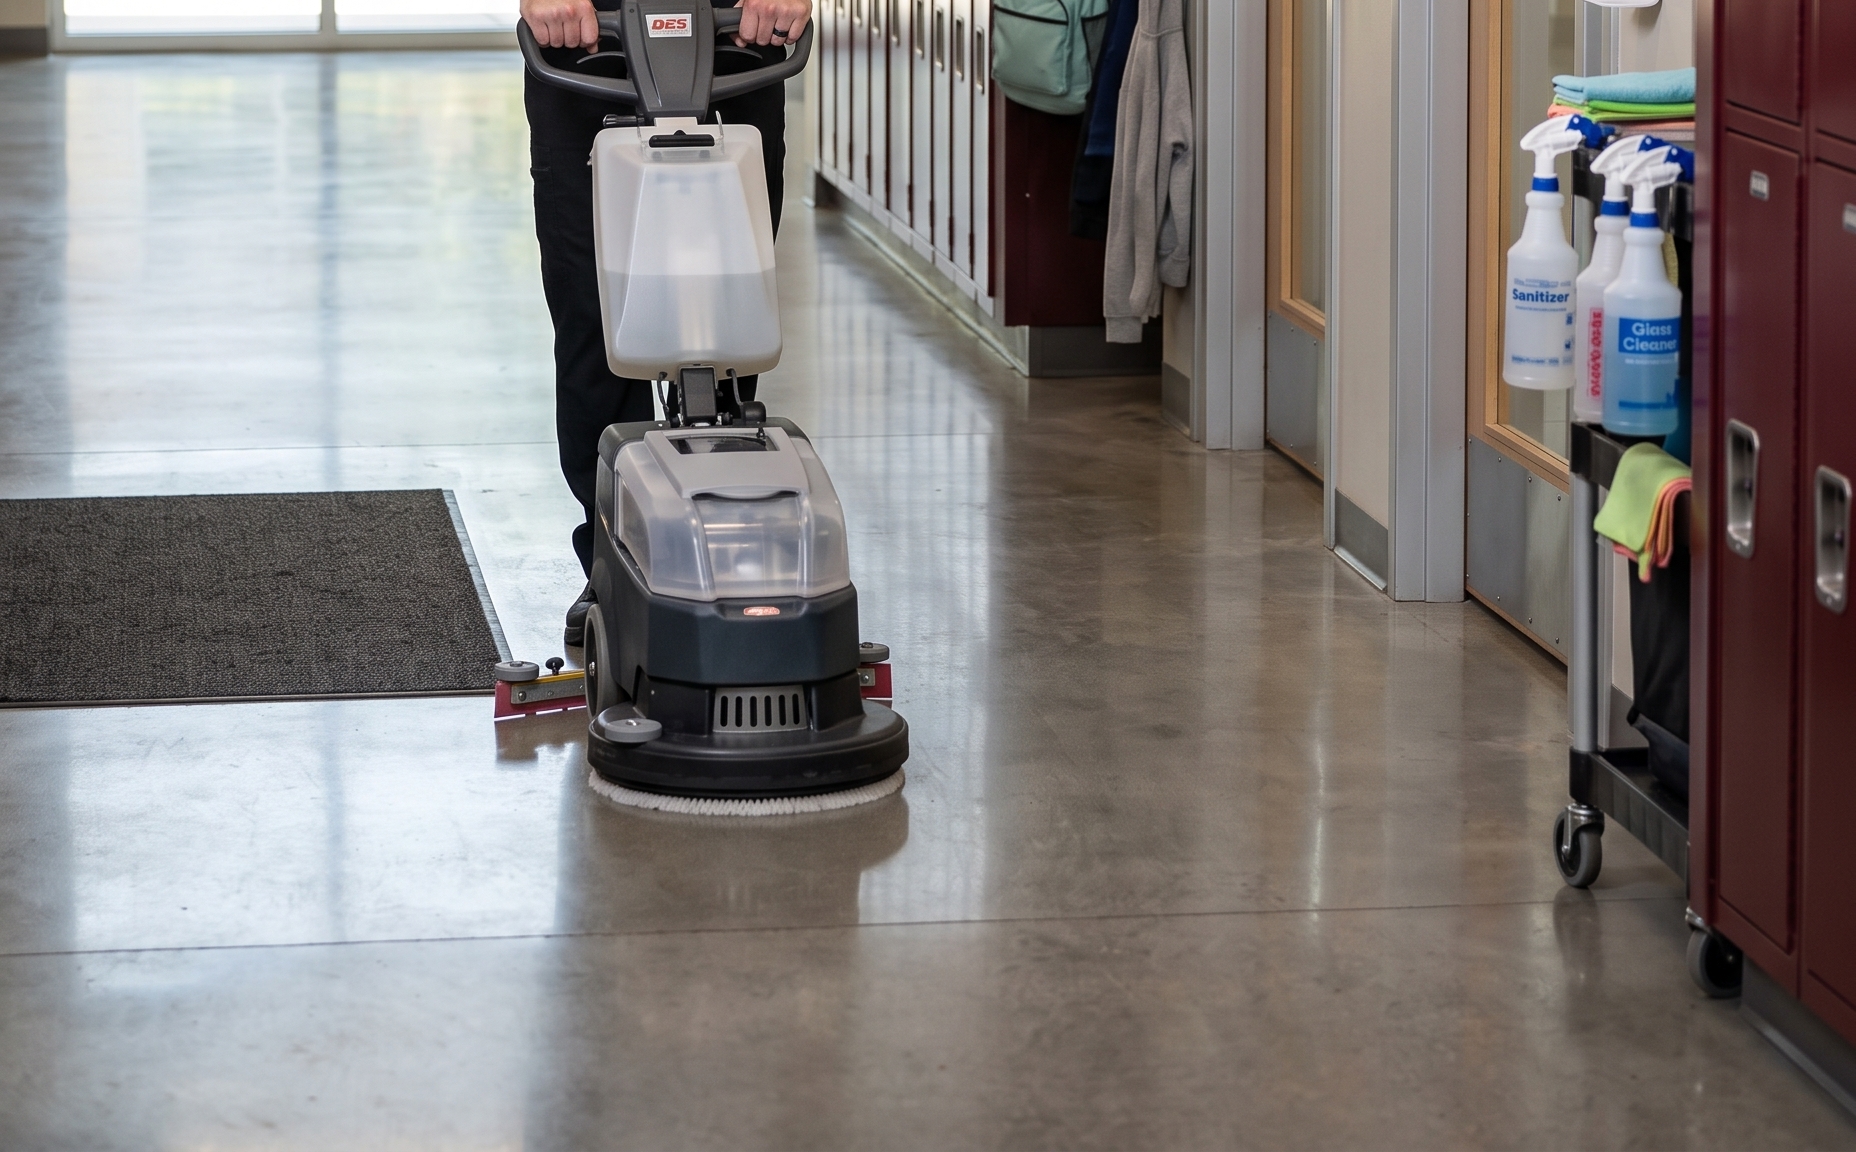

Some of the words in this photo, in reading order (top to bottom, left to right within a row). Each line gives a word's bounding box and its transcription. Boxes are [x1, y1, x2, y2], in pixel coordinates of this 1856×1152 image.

[652, 18, 687, 30] DES
[1512, 288, 1570, 303] Sanitizer
[1631, 322, 1672, 336] Glass
[1623, 337, 1677, 351] Cleaner
